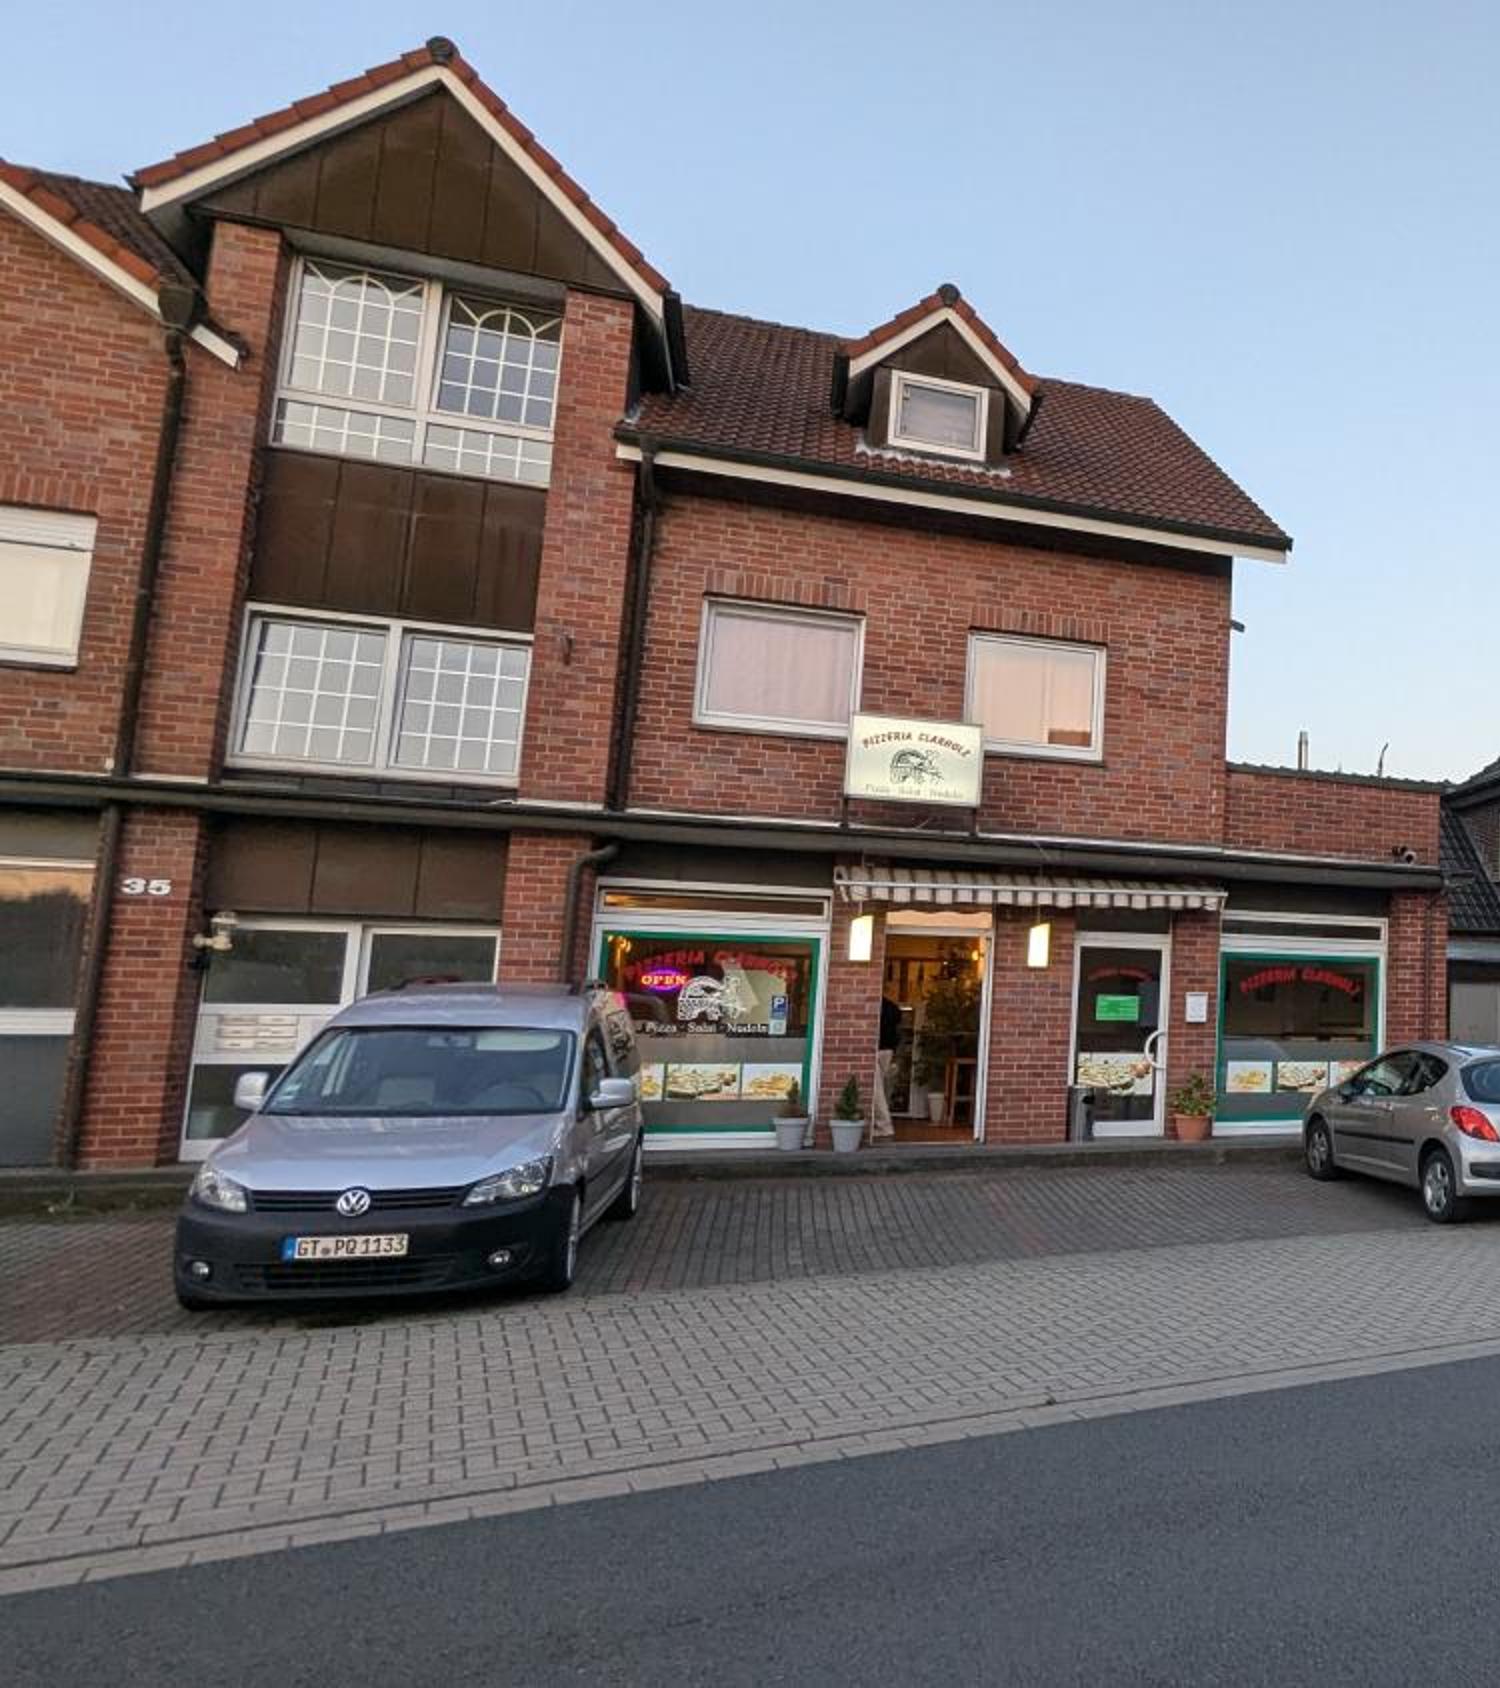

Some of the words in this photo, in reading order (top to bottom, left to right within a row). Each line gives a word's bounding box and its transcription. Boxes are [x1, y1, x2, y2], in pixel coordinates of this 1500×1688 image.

[121, 878, 172, 895] 35
[641, 975, 687, 986] OPEN
[297, 1240, 320, 1256] GT
